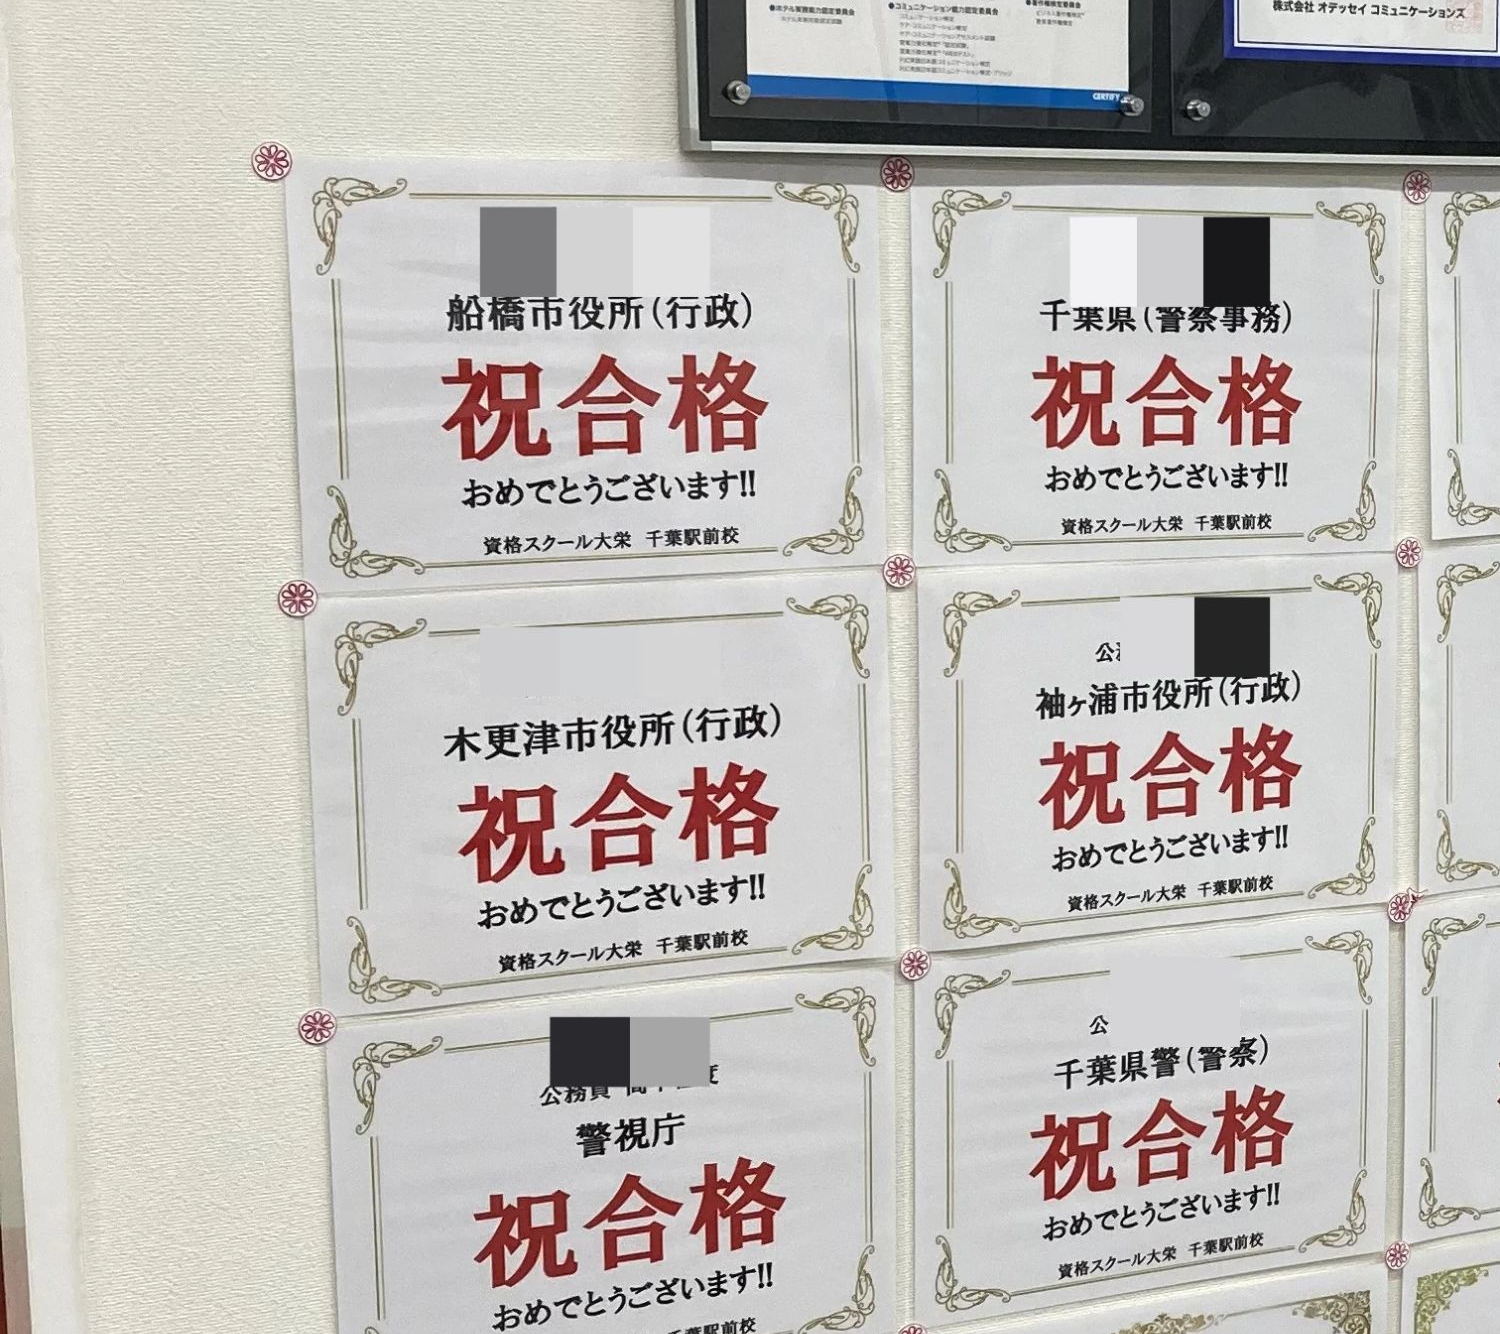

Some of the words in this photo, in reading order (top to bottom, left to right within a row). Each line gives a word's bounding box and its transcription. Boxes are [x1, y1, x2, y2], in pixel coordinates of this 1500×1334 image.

[1273, 0, 1314, 13] 株式会社
[1317, 2, 1366, 15] オデッセイ
[1370, 4, 1466, 19] コミュニケーションズ
[441, 351, 769, 461] 祝合格
[444, 703, 782, 761] 木更津市役所(行政)
[1038, 722, 1302, 831] 祝合格
[576, 1113, 685, 1158] 警視庁
[473, 1156, 786, 1289] 祝合格
